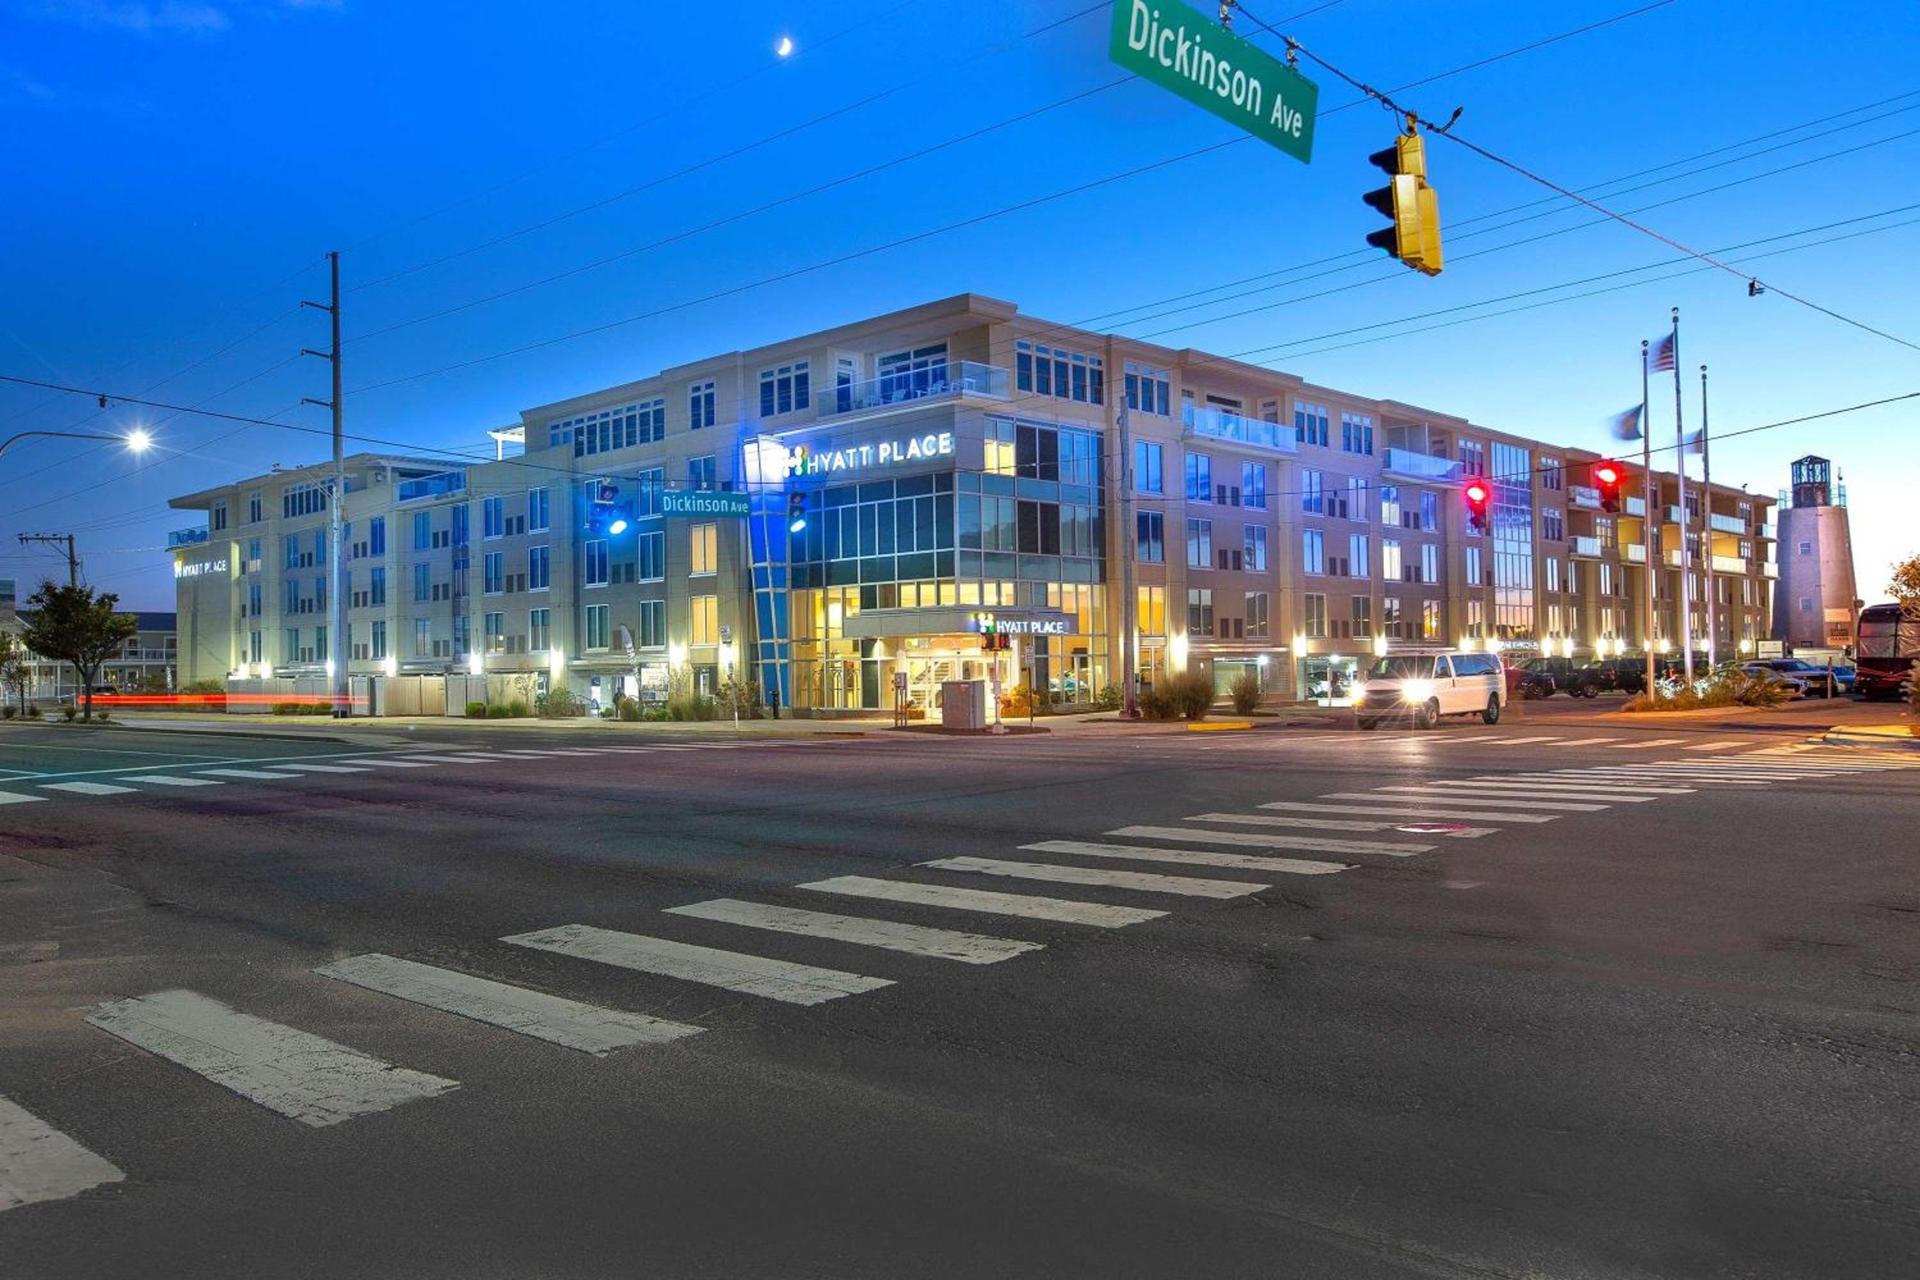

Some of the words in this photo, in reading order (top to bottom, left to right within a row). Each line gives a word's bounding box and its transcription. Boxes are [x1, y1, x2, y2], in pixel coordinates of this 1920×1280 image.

[1128, 0, 1262, 116] Dickinson
[1270, 93, 1303, 138] Ave
[807, 446, 871, 475] HYATT
[878, 432, 952, 464] PLACE
[663, 495, 728, 513] Dickinson
[730, 501, 749, 513] Ave
[996, 621, 1028, 633] HYATT
[1031, 621, 1063, 633] PLACE
